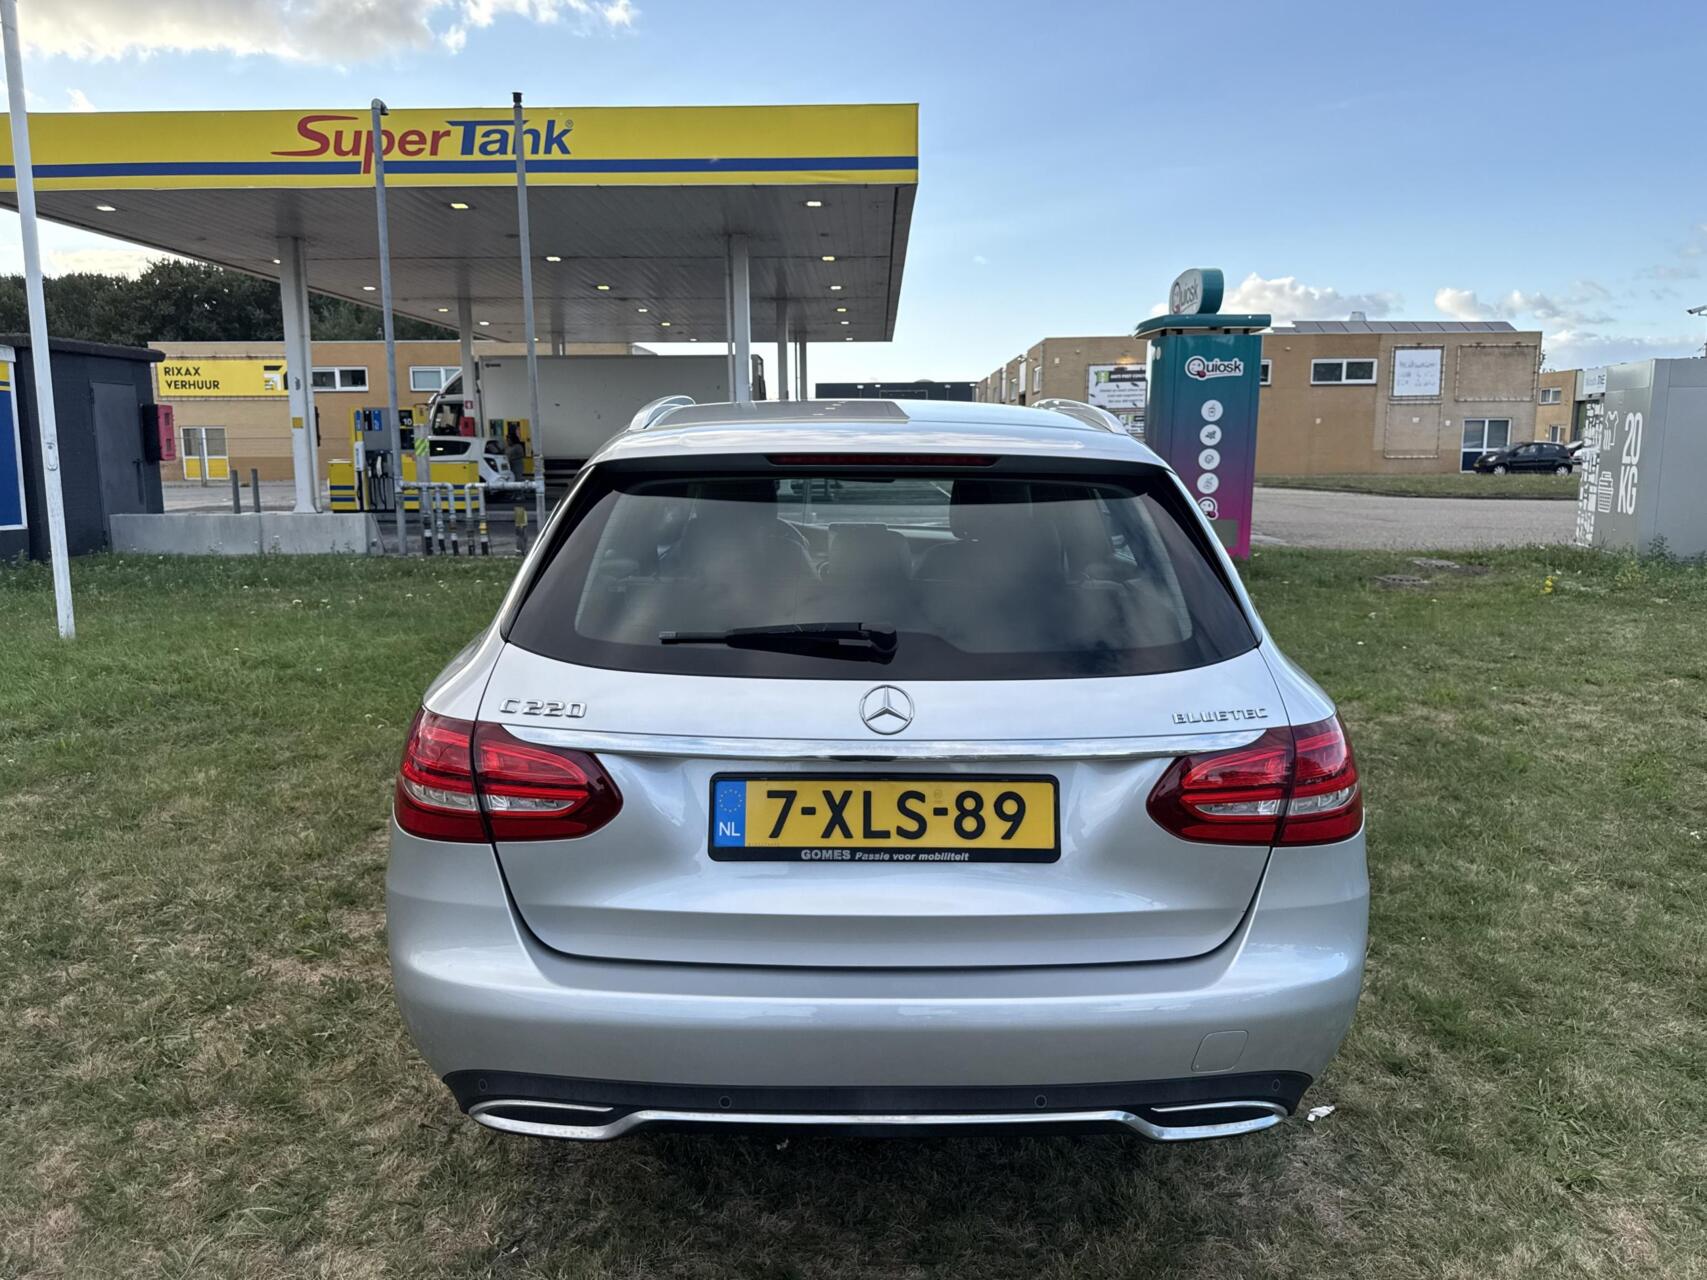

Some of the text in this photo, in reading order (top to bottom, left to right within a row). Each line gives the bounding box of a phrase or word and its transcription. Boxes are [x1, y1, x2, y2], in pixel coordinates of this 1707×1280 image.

[163, 366, 201, 376] RIXAX
[1187, 357, 1242, 377] Quiosk
[165, 379, 220, 390] VERHUUR
[1622, 412, 1643, 465] 20
[1617, 465, 1638, 515] KG
[500, 699, 587, 718] C 220
[1172, 708, 1268, 724] BLUETEC
[766, 789, 1027, 840] 7-XLS-89
[719, 821, 741, 837] NL
[801, 849, 970, 861] GOMES Passie voor mobiliteit
